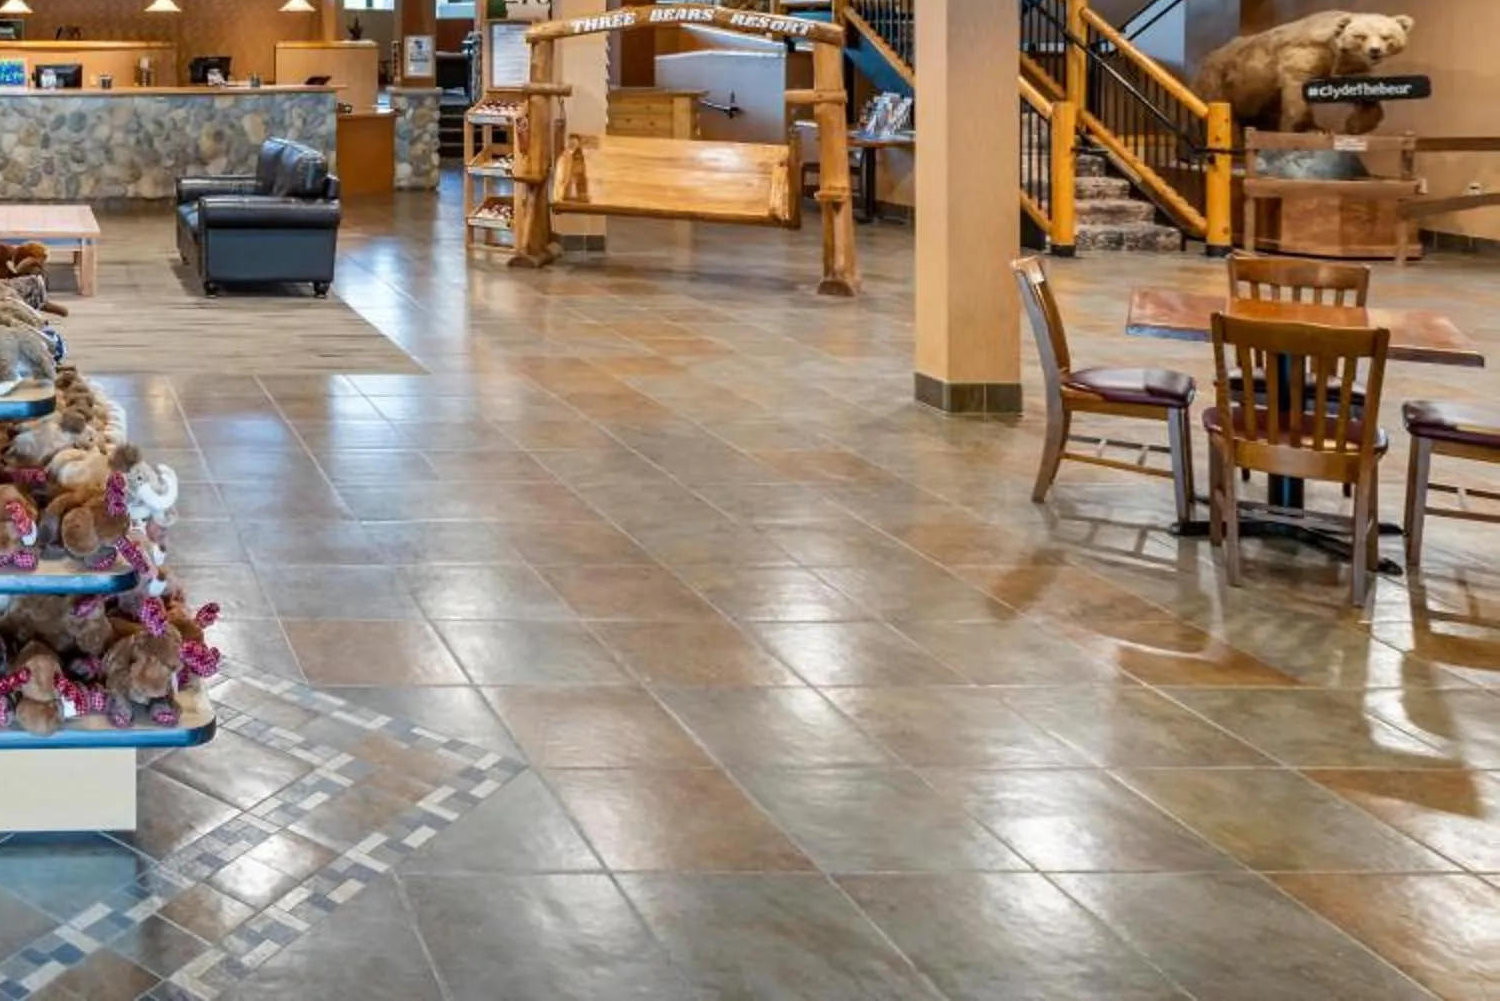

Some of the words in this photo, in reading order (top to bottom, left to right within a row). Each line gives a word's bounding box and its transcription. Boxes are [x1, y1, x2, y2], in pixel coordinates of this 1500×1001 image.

[569, 11, 637, 34] THREE
[649, 7, 715, 22] BEARS
[730, 13, 816, 36] RESORT
[1307, 82, 1412, 99] #clydethebear
